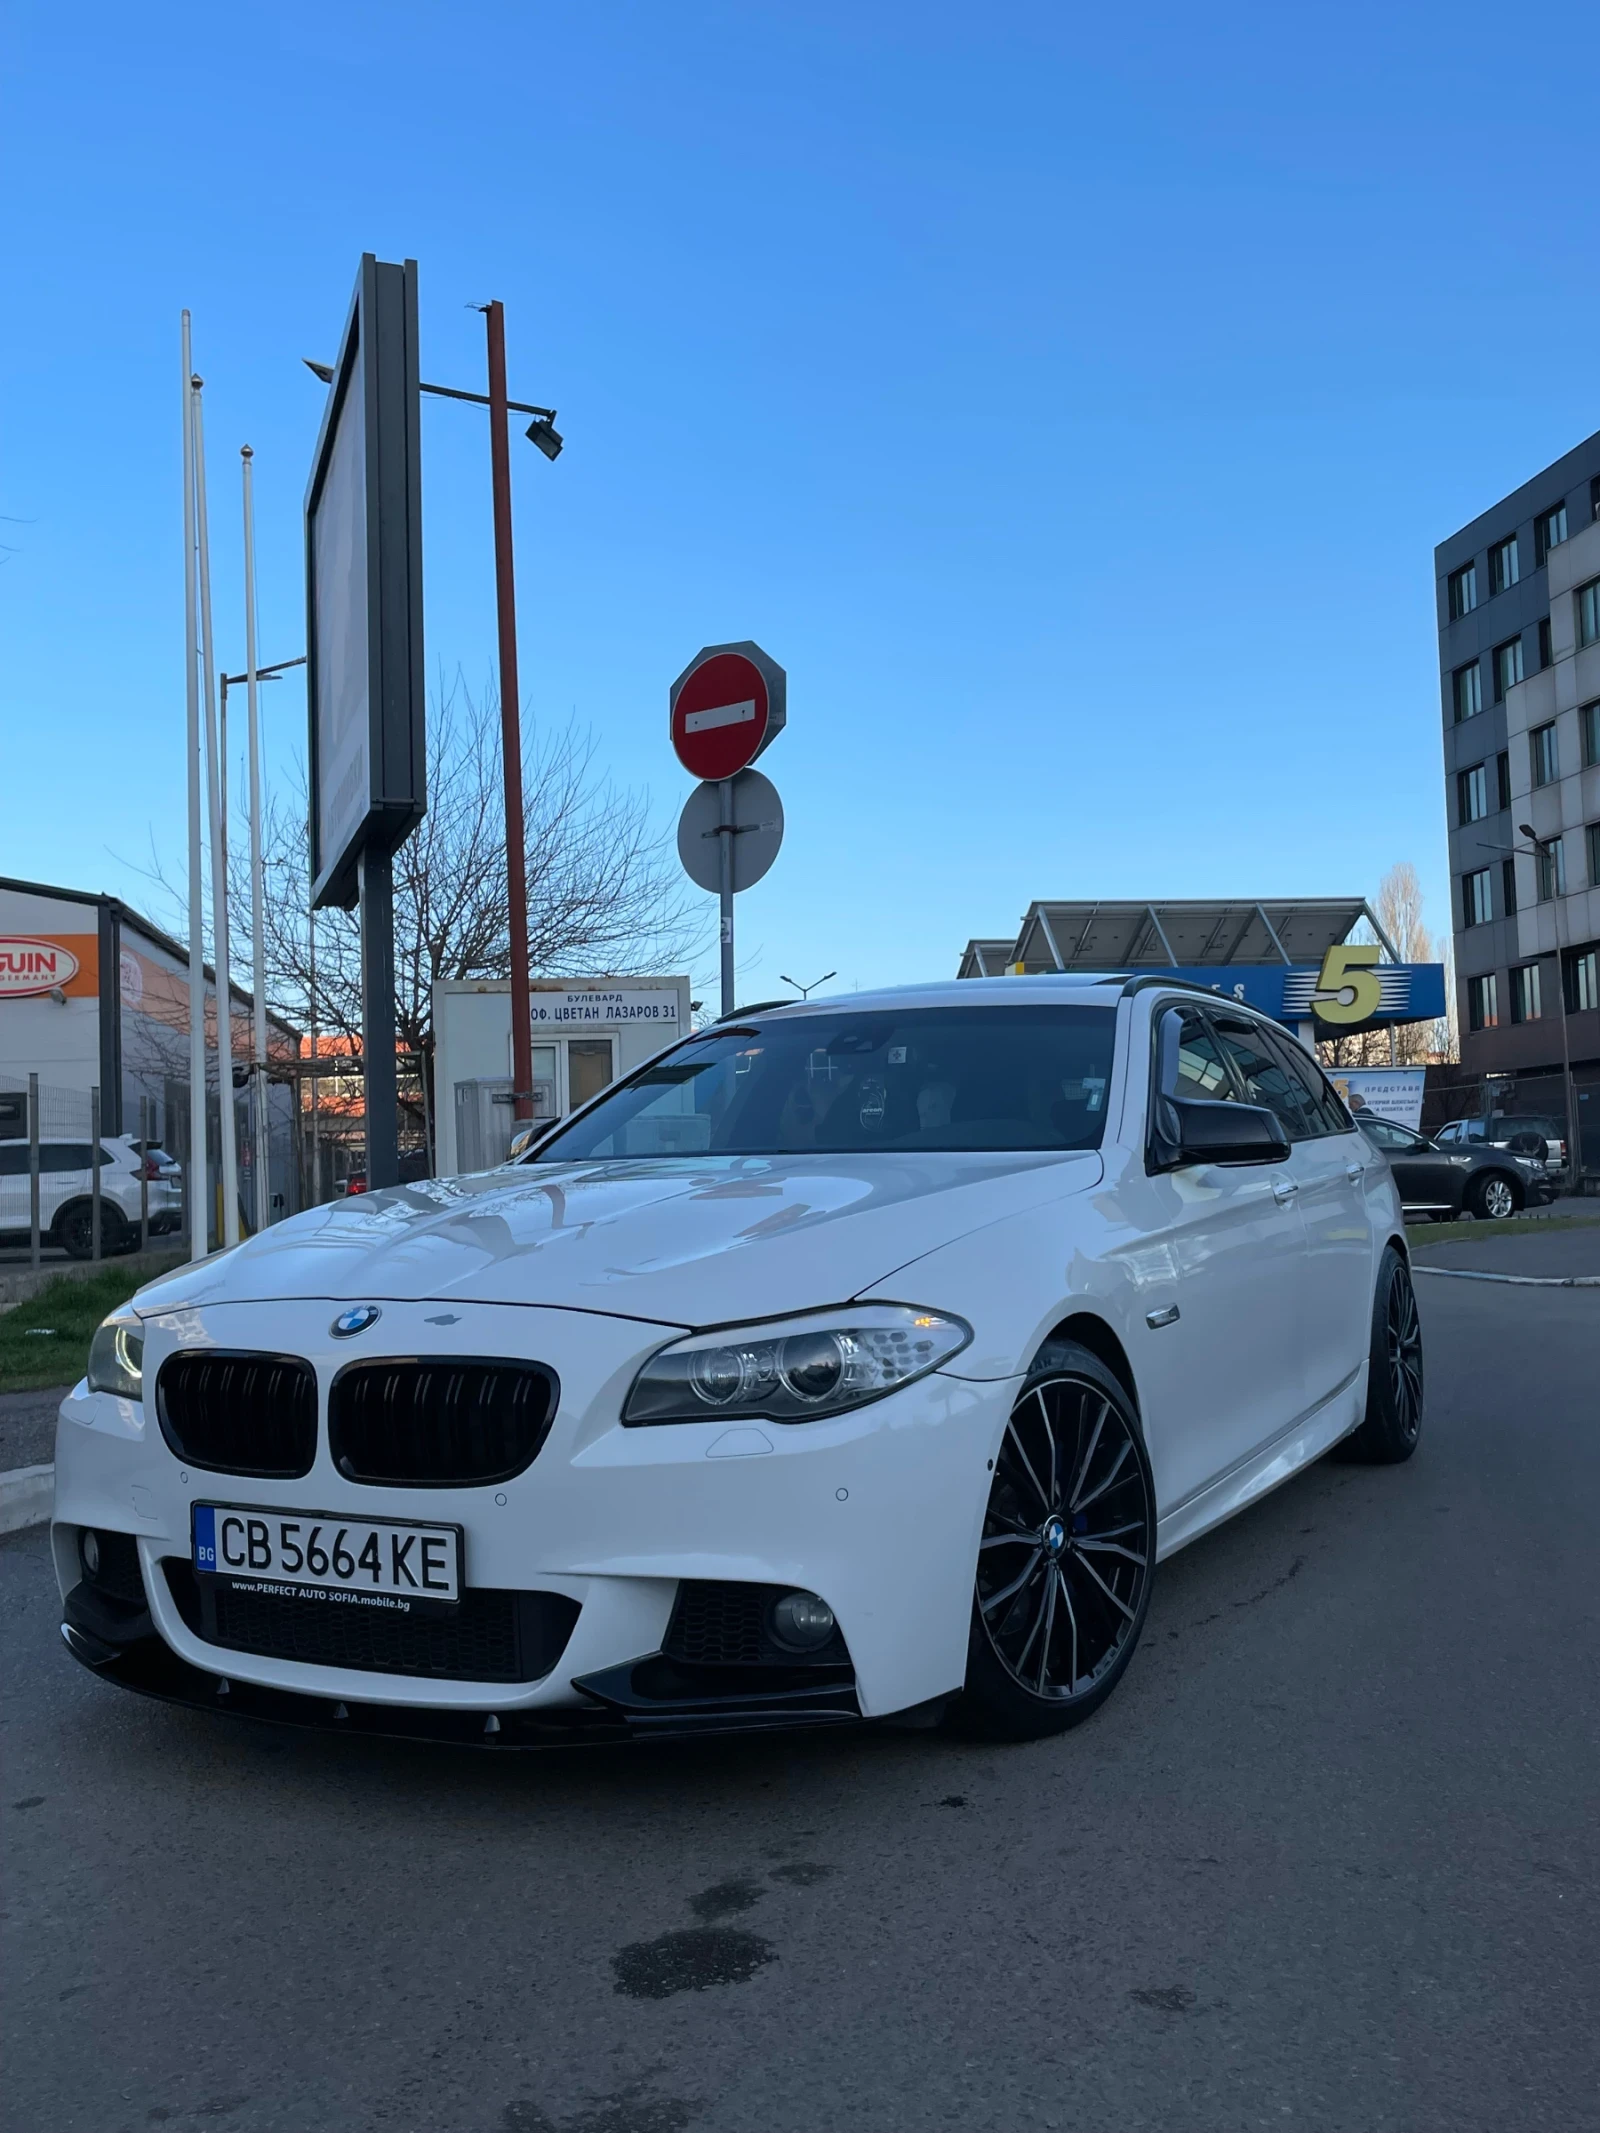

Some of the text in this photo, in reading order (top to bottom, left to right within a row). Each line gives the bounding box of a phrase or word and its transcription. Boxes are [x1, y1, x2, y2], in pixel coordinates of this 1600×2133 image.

[1309, 944, 1382, 1024] 5
[567, 993, 623, 1003] БУЛЕВАРД
[531, 1005, 676, 1022] ОФ. ЦВЕТАН ЛАЗАРОВ 31
[198, 1546, 215, 1562] BG
[221, 1517, 450, 1591] CB 5664 KE
[231, 1581, 410, 1612] www.PERFECT AUTO SOFIA.mobile.bg
